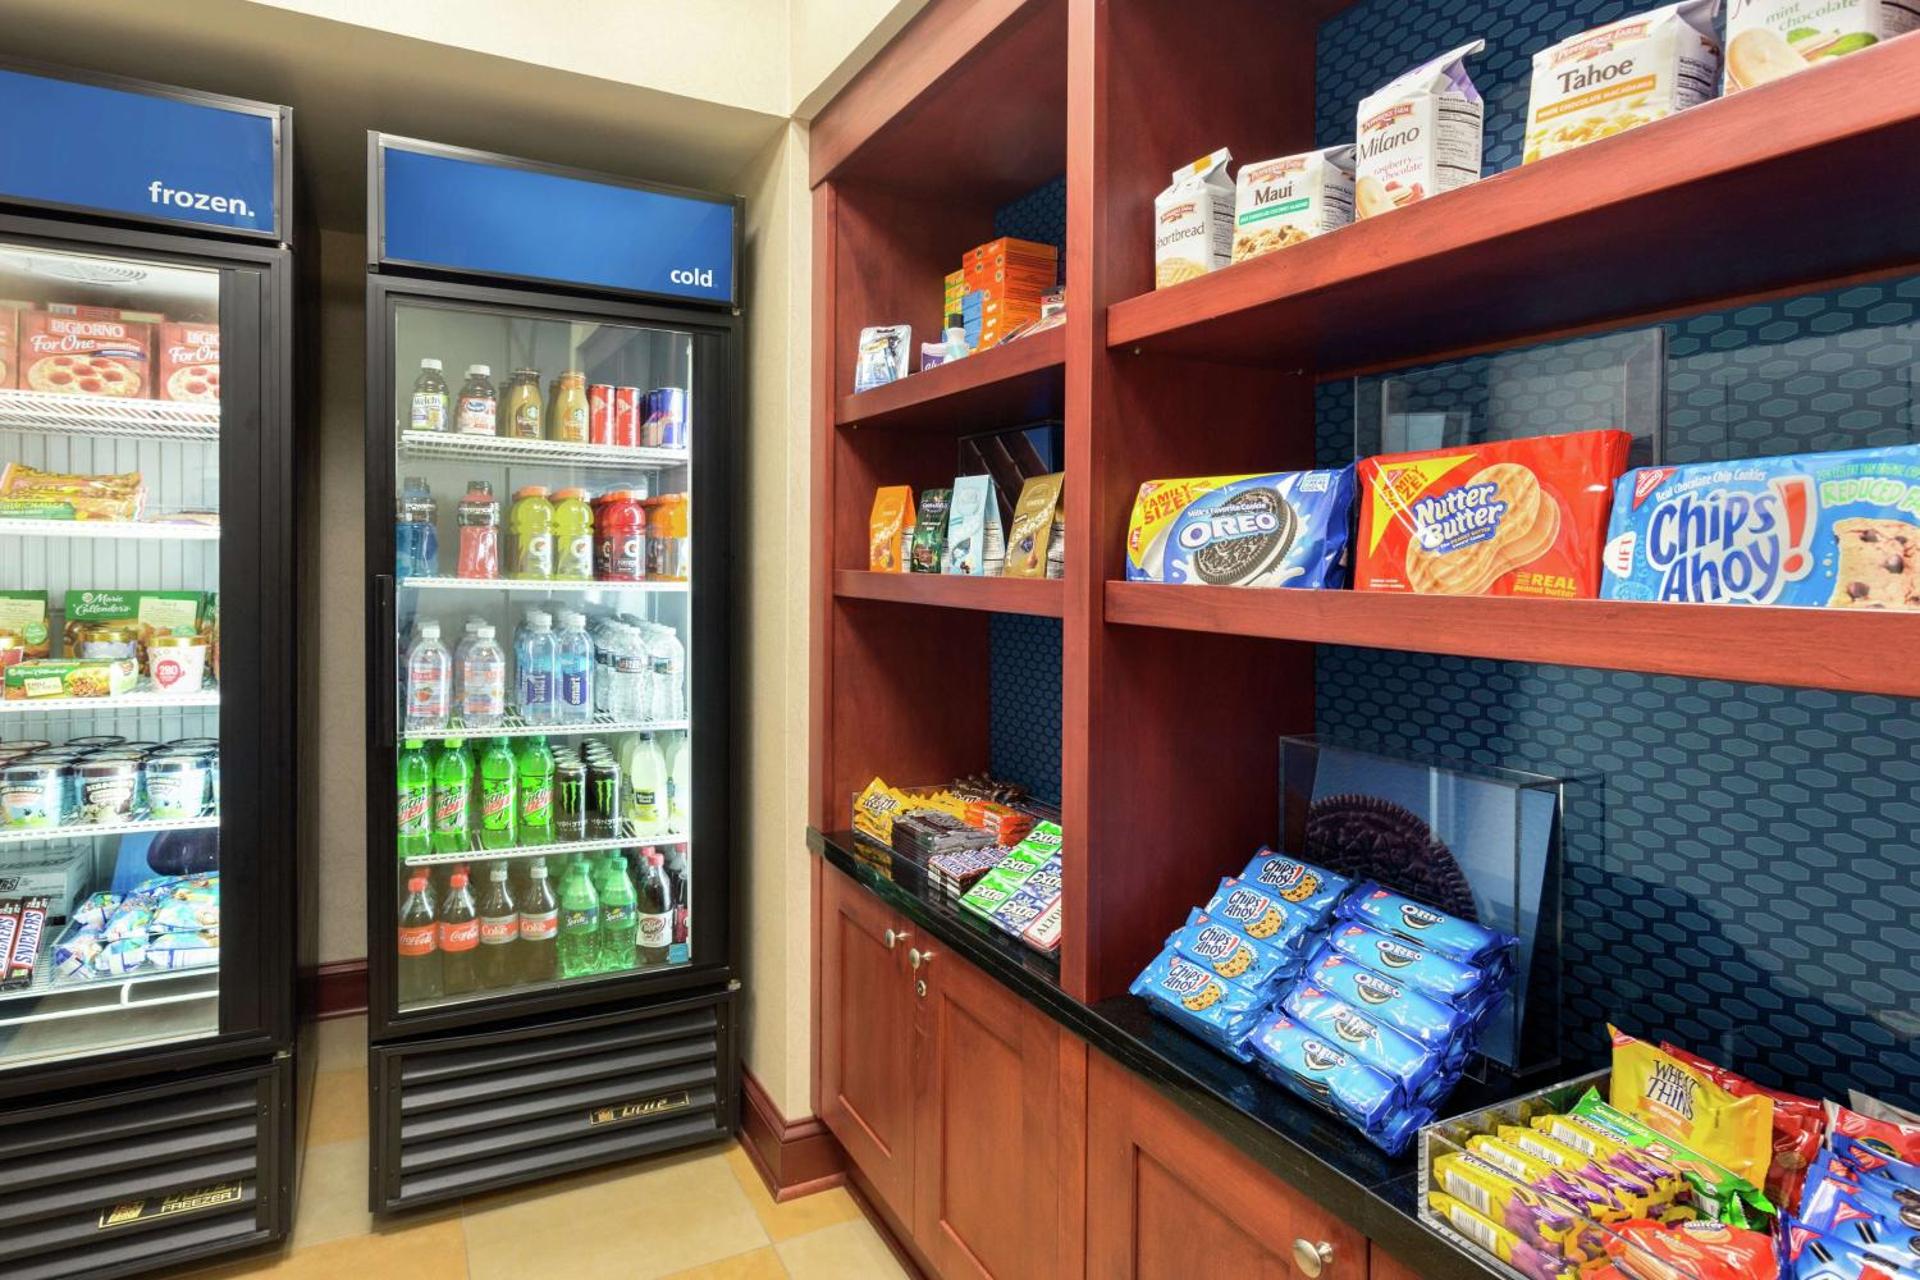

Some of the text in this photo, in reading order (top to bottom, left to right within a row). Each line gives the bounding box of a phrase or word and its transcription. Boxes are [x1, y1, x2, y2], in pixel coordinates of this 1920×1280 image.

[1556, 58, 1634, 94] Tahoe
[1357, 127, 1421, 168] Milano
[148, 181, 256, 217] frozen.
[1254, 181, 1294, 207] Maui
[1712, 469, 1733, 483] Chip
[1733, 467, 1768, 482] Cookies
[1143, 483, 1192, 512] FAMILY
[1413, 485, 1495, 527] Nutter
[1179, 512, 1279, 549] OREO
[1418, 503, 1505, 550] Butter
[1649, 494, 1779, 567] Chips
[1616, 539, 1632, 572] LIFT
[1531, 573, 1577, 592] REAL
[1263, 859, 1297, 877] Chips
[1228, 889, 1262, 909] Chips
[14, 911, 43, 964] SNICKERS
[481, 924, 509, 937] Coke
[521, 920, 546, 932] Coke
[1199, 927, 1232, 946] Chips
[1169, 964, 1201, 981] Chips
[1653, 1060, 1701, 1092] WHEAT
[1646, 1076, 1694, 1121] THINS
